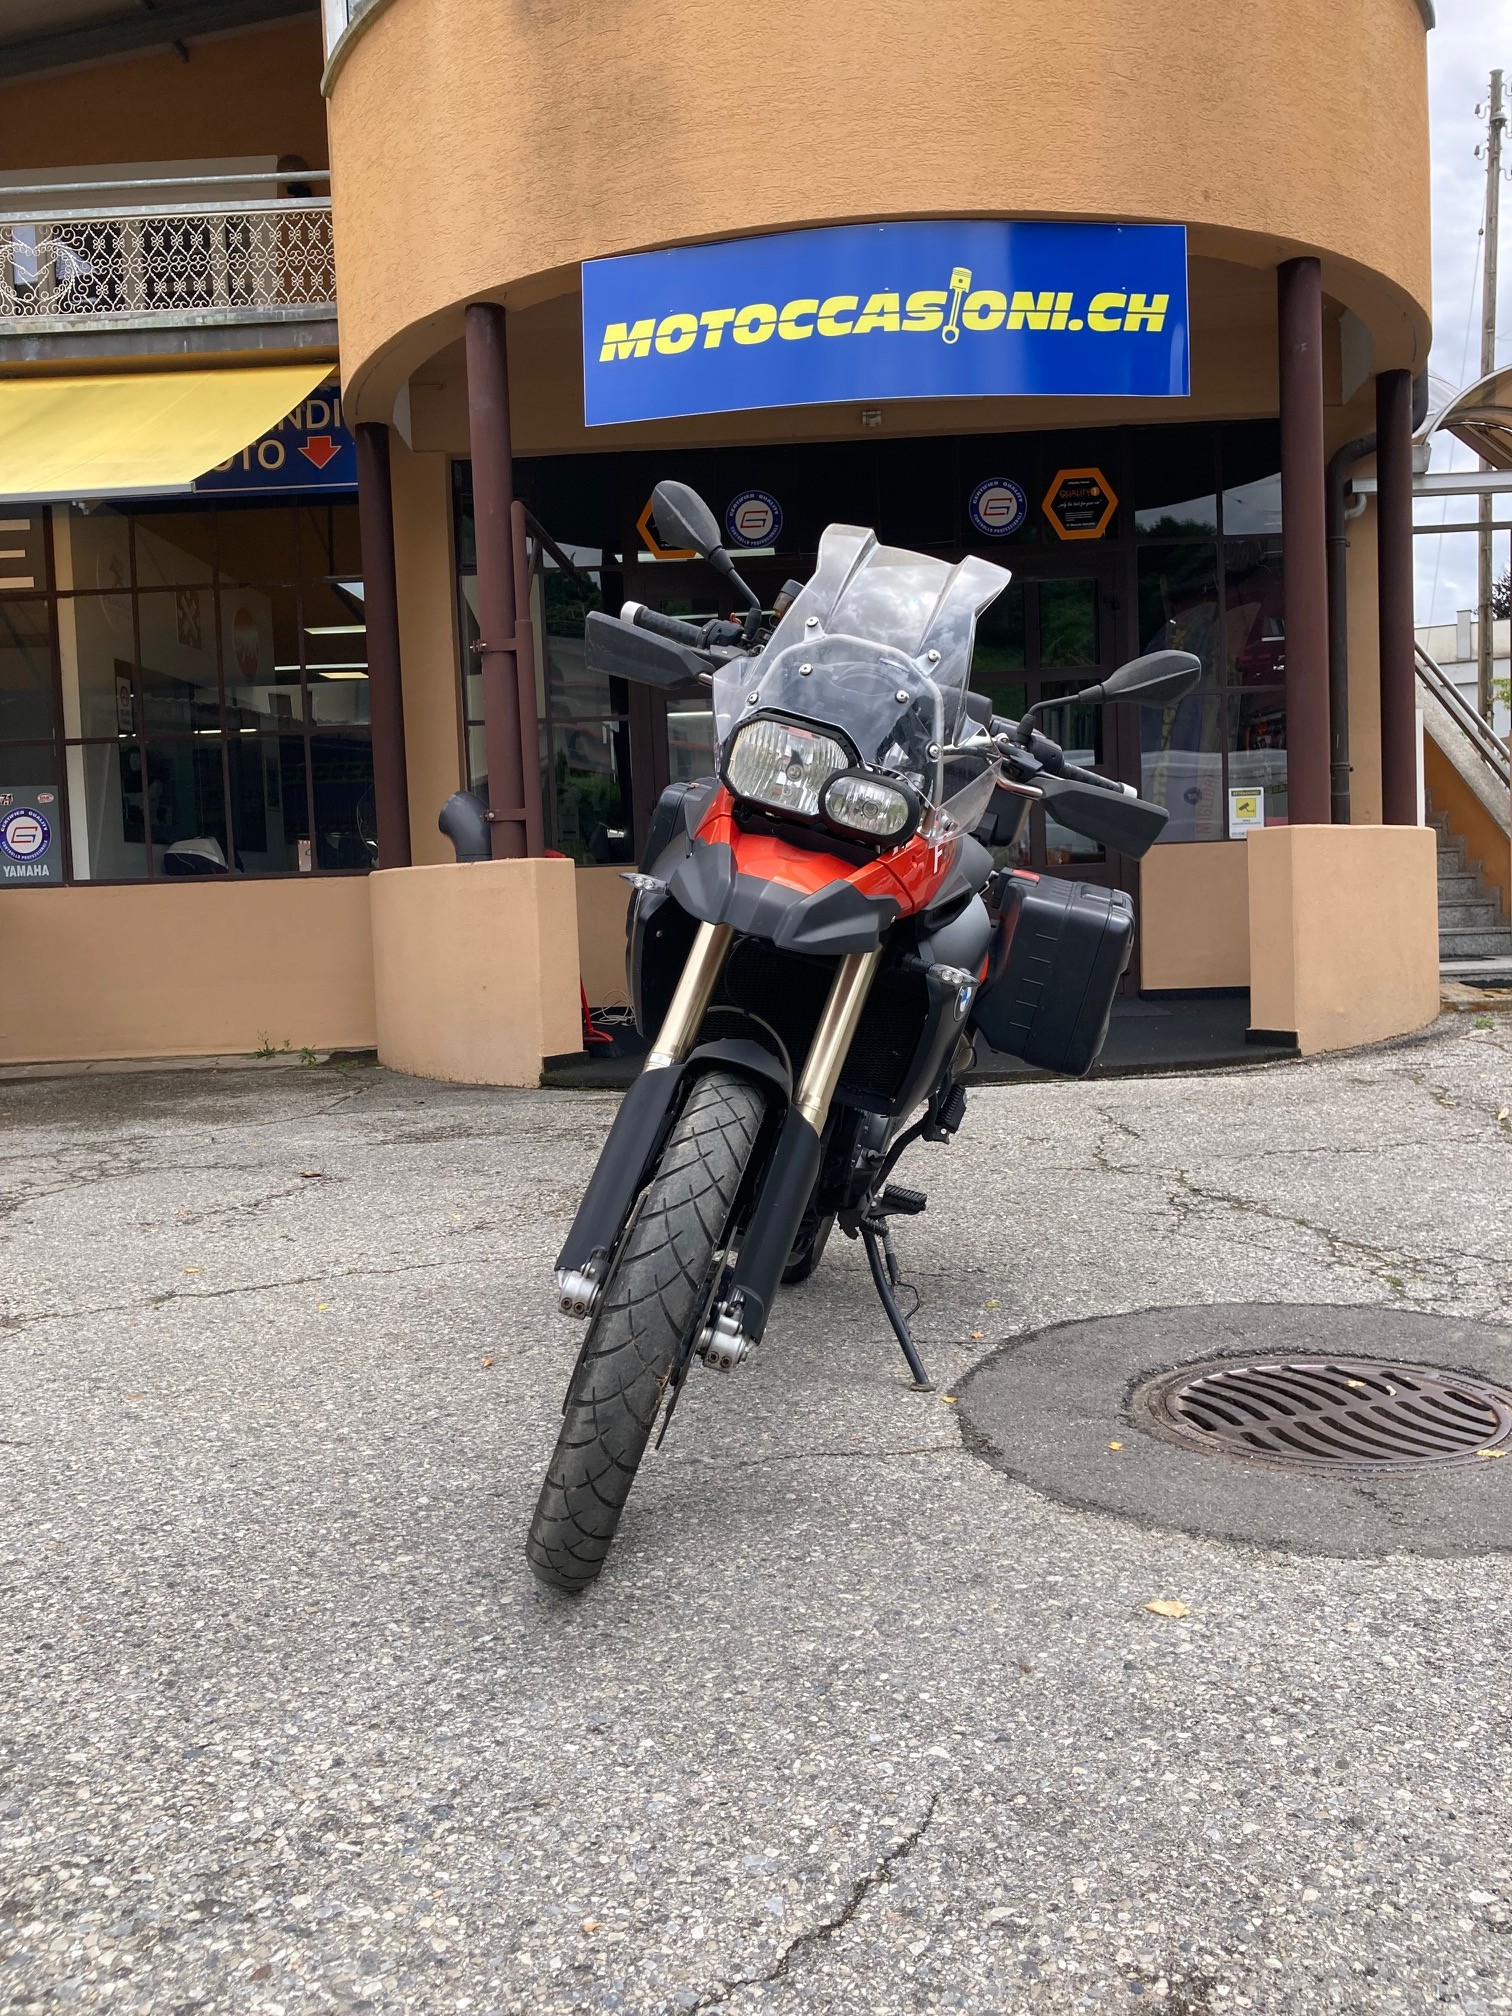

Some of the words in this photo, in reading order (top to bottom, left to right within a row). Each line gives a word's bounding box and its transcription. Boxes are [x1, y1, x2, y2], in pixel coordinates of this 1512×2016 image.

[599, 267, 1170, 362] MOTOCCASIONI.CH
[271, 399, 341, 430] NDI
[973, 481, 999, 504] CERTIFIED
[1002, 482, 1023, 502] QUALITY
[729, 494, 755, 517] CERTIFIED
[758, 494, 780, 515] QUALITY
[1, 810, 25, 832] CERTIFIED
[28, 810, 48, 831] QUALITY
[3, 864, 50, 877] YAMAHA
